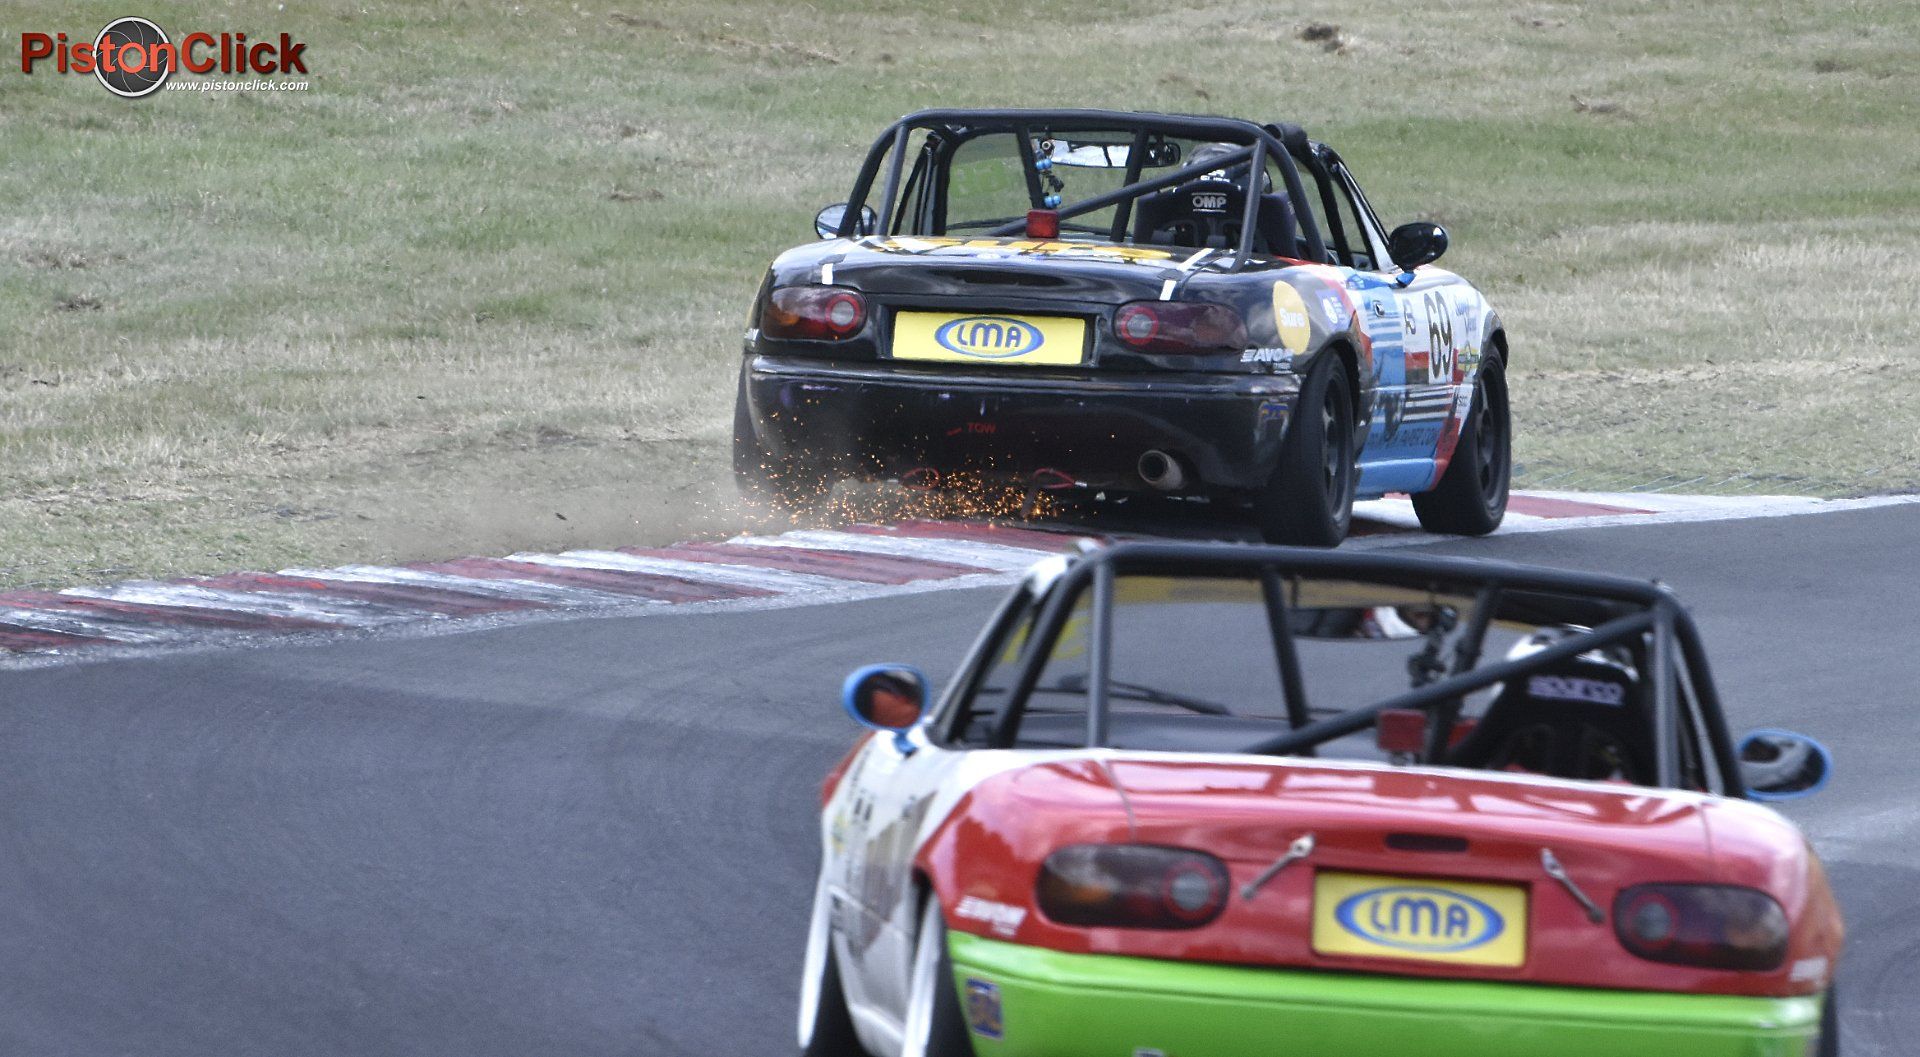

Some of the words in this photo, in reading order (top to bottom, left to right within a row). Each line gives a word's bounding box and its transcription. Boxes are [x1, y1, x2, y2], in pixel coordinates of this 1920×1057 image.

[1192, 196, 1227, 208] OMP
[1280, 308, 1305, 327] Sure
[957, 323, 1022, 348] LMA
[1424, 291, 1453, 379] 69
[1370, 897, 1469, 937] LMA
